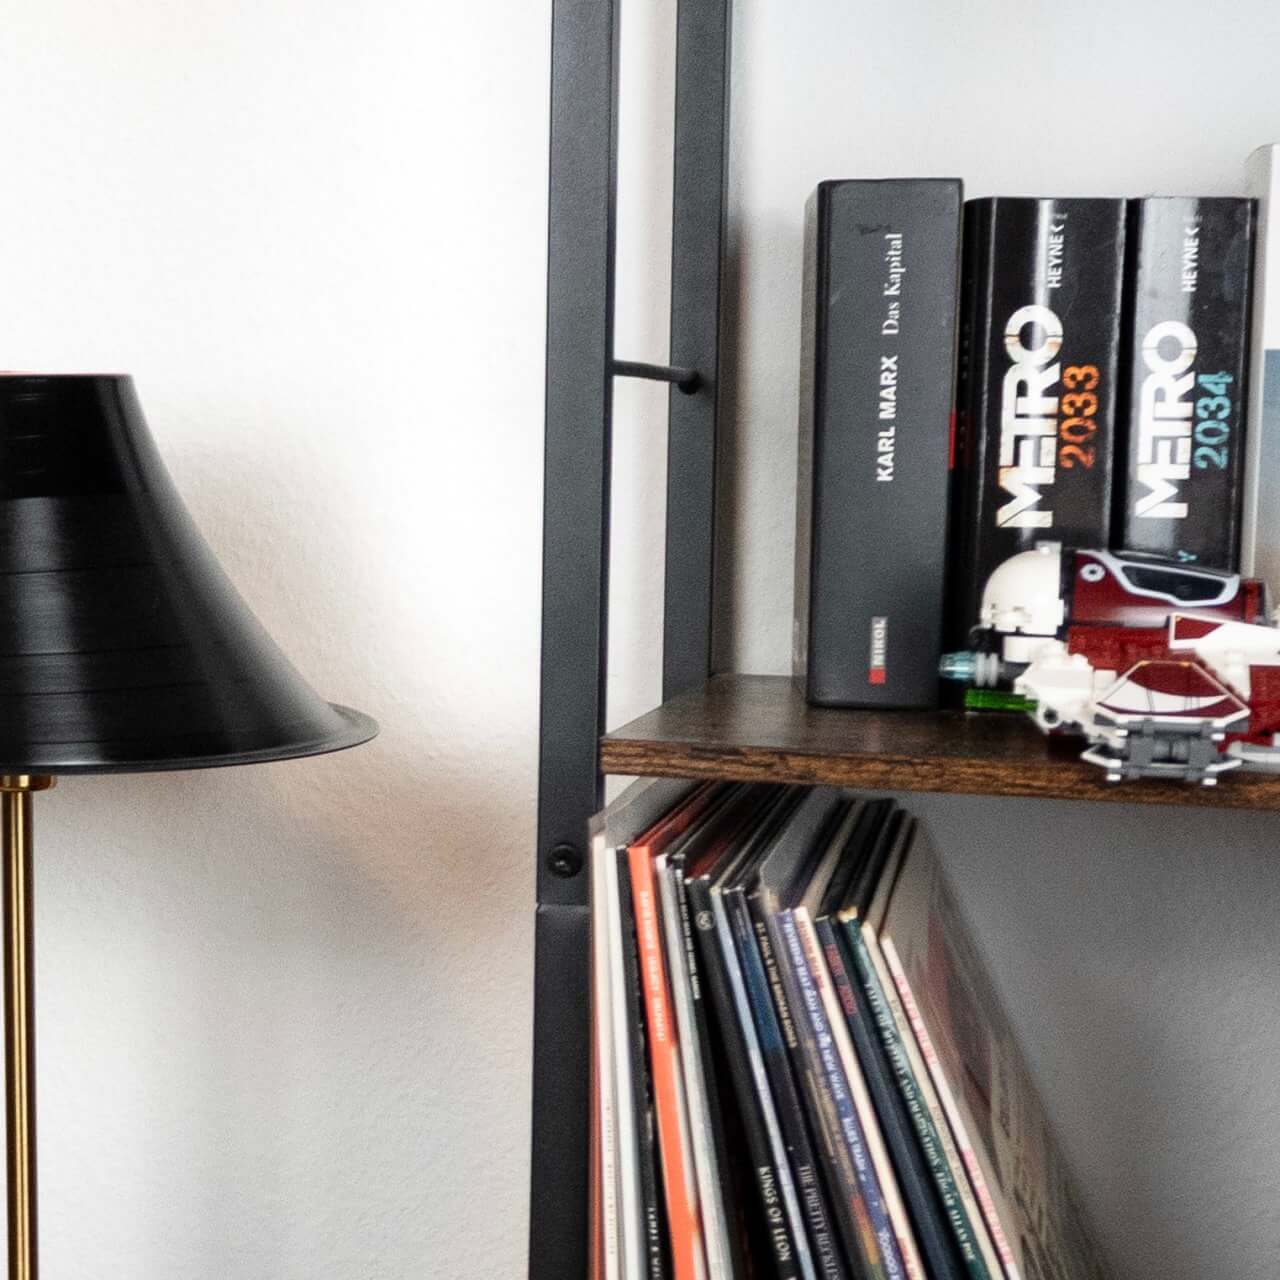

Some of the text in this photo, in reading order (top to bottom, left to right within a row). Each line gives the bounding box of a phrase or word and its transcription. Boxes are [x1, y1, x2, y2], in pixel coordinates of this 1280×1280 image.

[876, 233, 906, 482] KARL MARX Das Kapital
[996, 304, 1063, 528] METRO
[1059, 364, 1100, 469] 2033
[1135, 320, 1198, 519] METRO
[1193, 370, 1234, 470] 2034
[871, 617, 887, 668] NIKOL
[756, 1165, 779, 1205] KINGS
[797, 1163, 815, 1187] THE
[767, 1205, 783, 1224] OF
[803, 1186, 826, 1231] PRETTY
[771, 1226, 792, 1262] LEON
